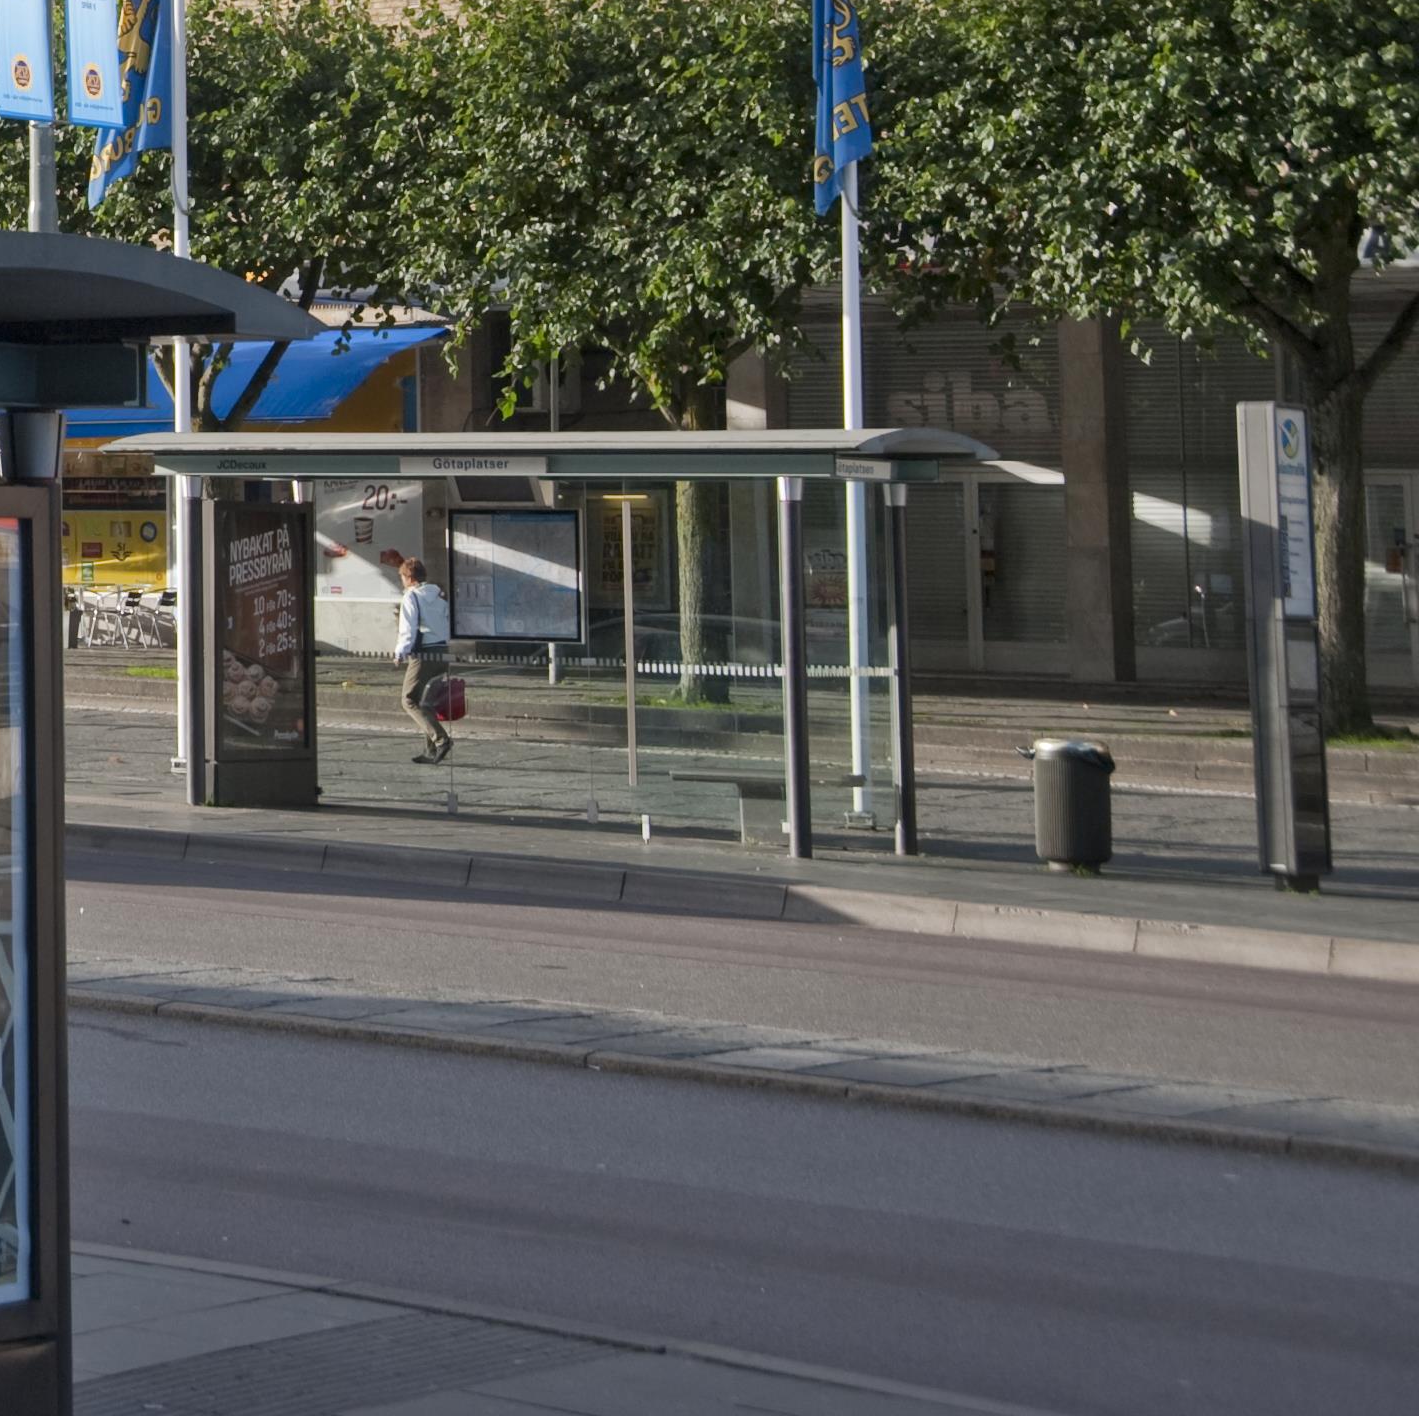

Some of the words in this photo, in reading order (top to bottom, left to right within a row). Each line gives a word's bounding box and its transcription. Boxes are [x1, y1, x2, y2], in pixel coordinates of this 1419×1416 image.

[216, 459, 267, 470] JCDecaux
[362, 484, 408, 511] 20:-
[229, 530, 275, 563] NYBAKAT
[276, 523, 290, 551] PÅ
[229, 548, 292, 587] PRESSBYRÅN
[253, 595, 265, 616] 10
[276, 589, 296, 609] 70:-
[259, 616, 265, 634] 4
[276, 611, 296, 629] 40:-
[258, 638, 265, 658] 2
[276, 631, 297, 653] 25:-
